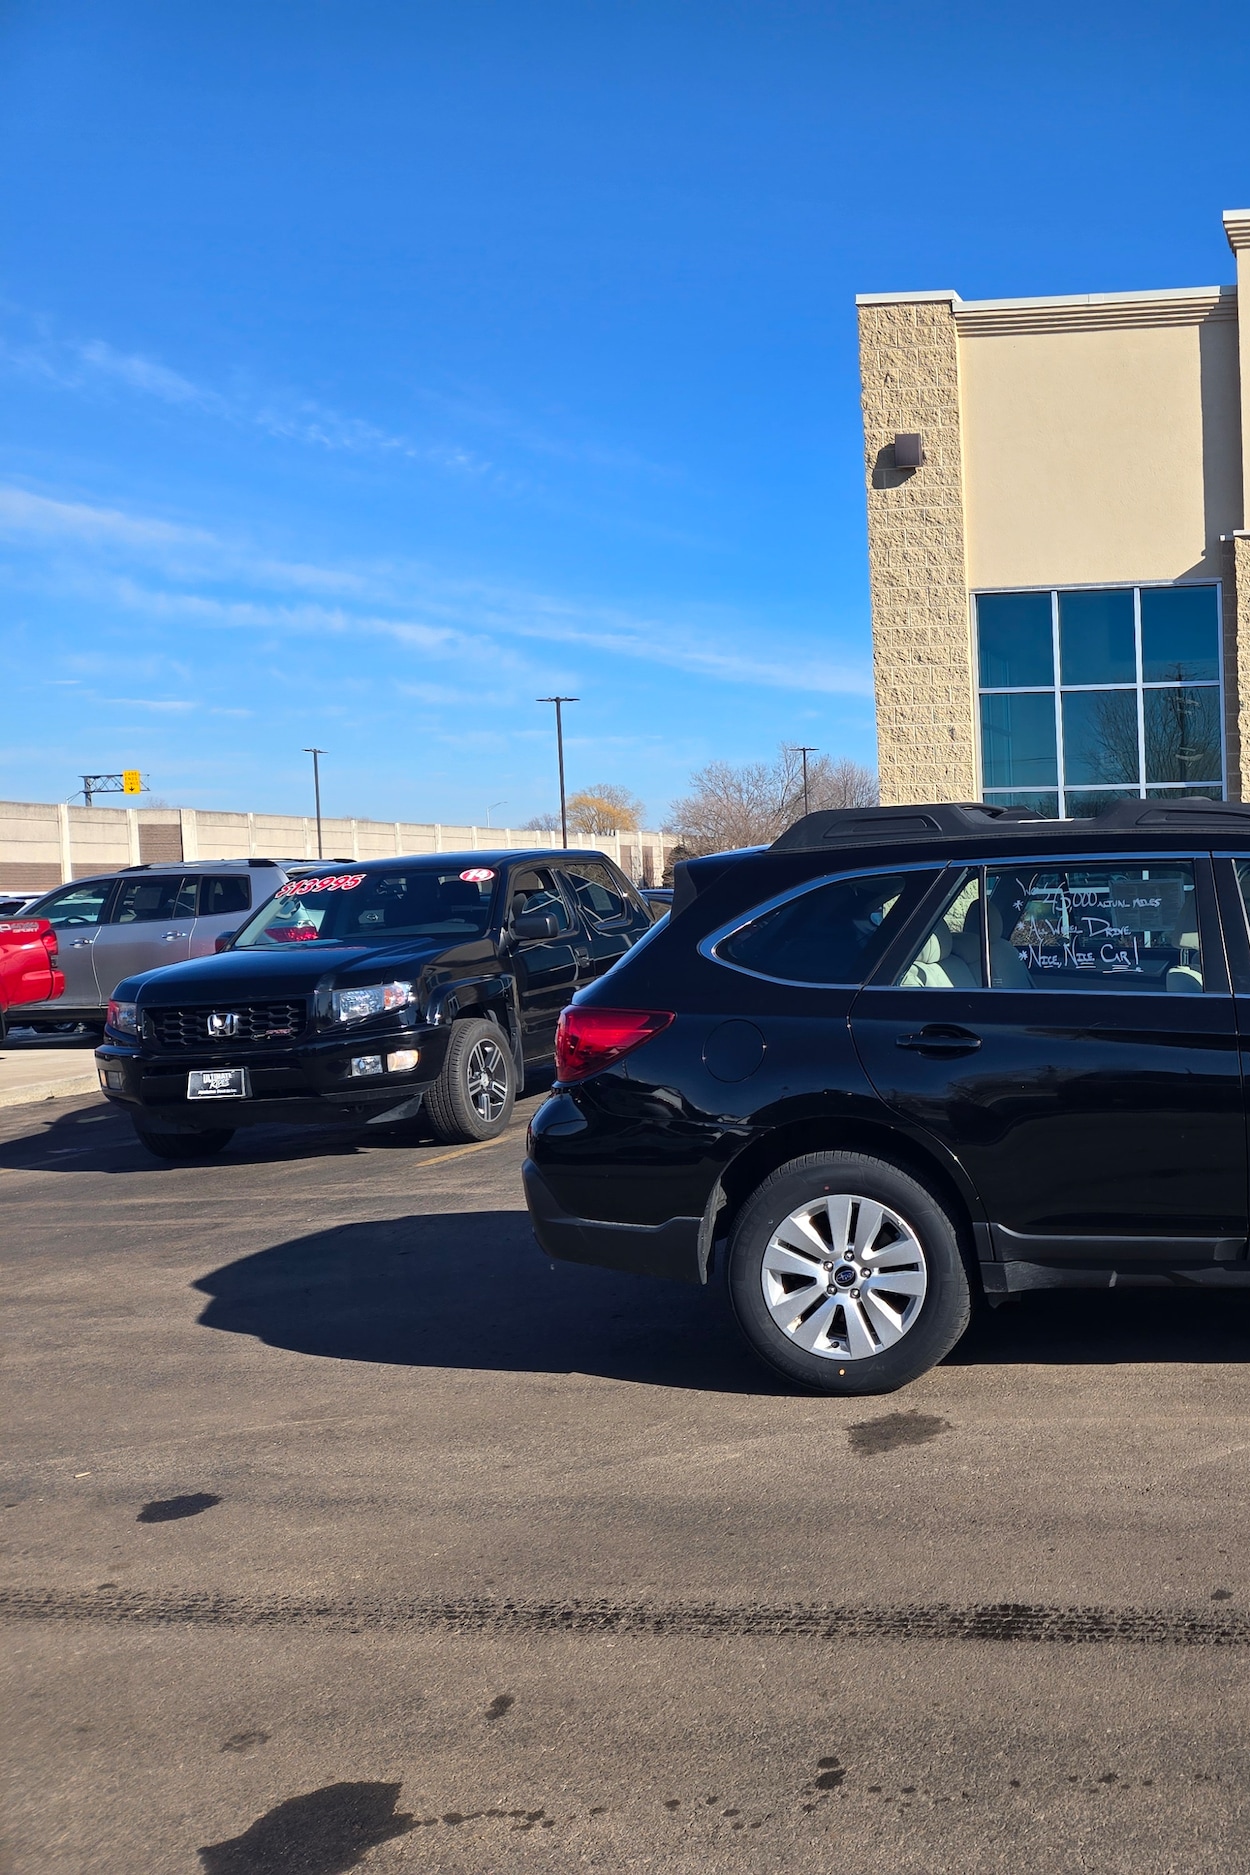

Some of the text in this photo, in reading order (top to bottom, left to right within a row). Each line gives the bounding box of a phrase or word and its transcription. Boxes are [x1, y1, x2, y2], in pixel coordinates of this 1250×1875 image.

[465, 868, 492, 881] 14
[274, 873, 367, 899] $13995
[202, 1073, 232, 1084] ULTIMATE
